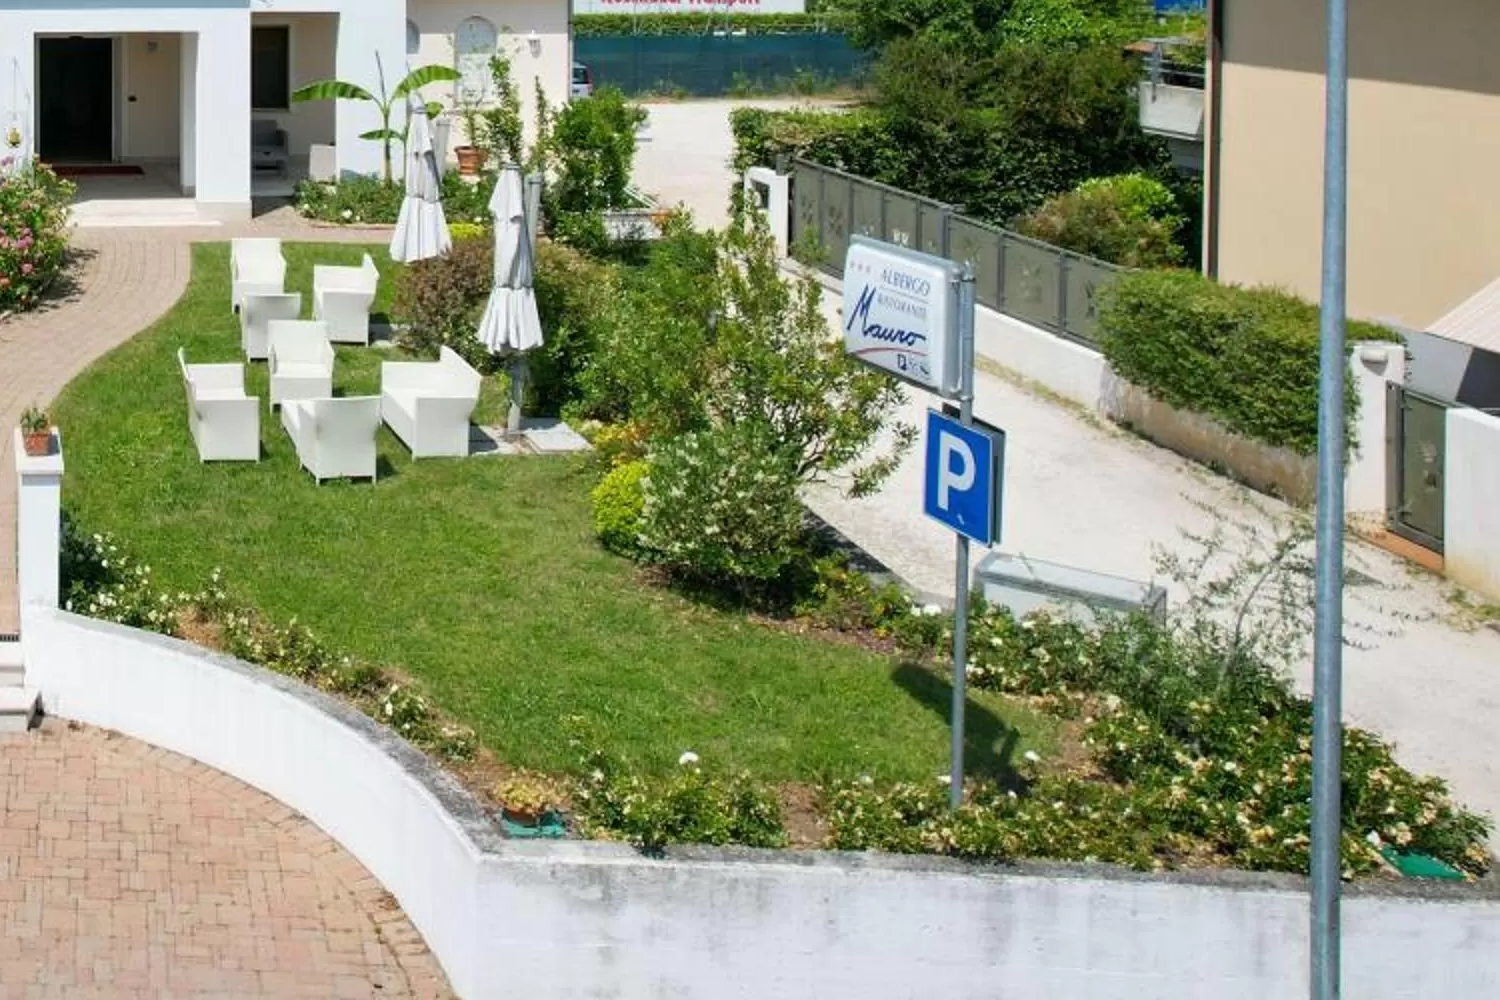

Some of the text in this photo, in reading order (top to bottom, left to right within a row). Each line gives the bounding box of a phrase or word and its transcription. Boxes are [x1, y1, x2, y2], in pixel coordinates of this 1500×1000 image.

[847, 283, 927, 346] Mauro
[881, 269, 931, 297] ALBERGO
[937, 429, 976, 512] P
